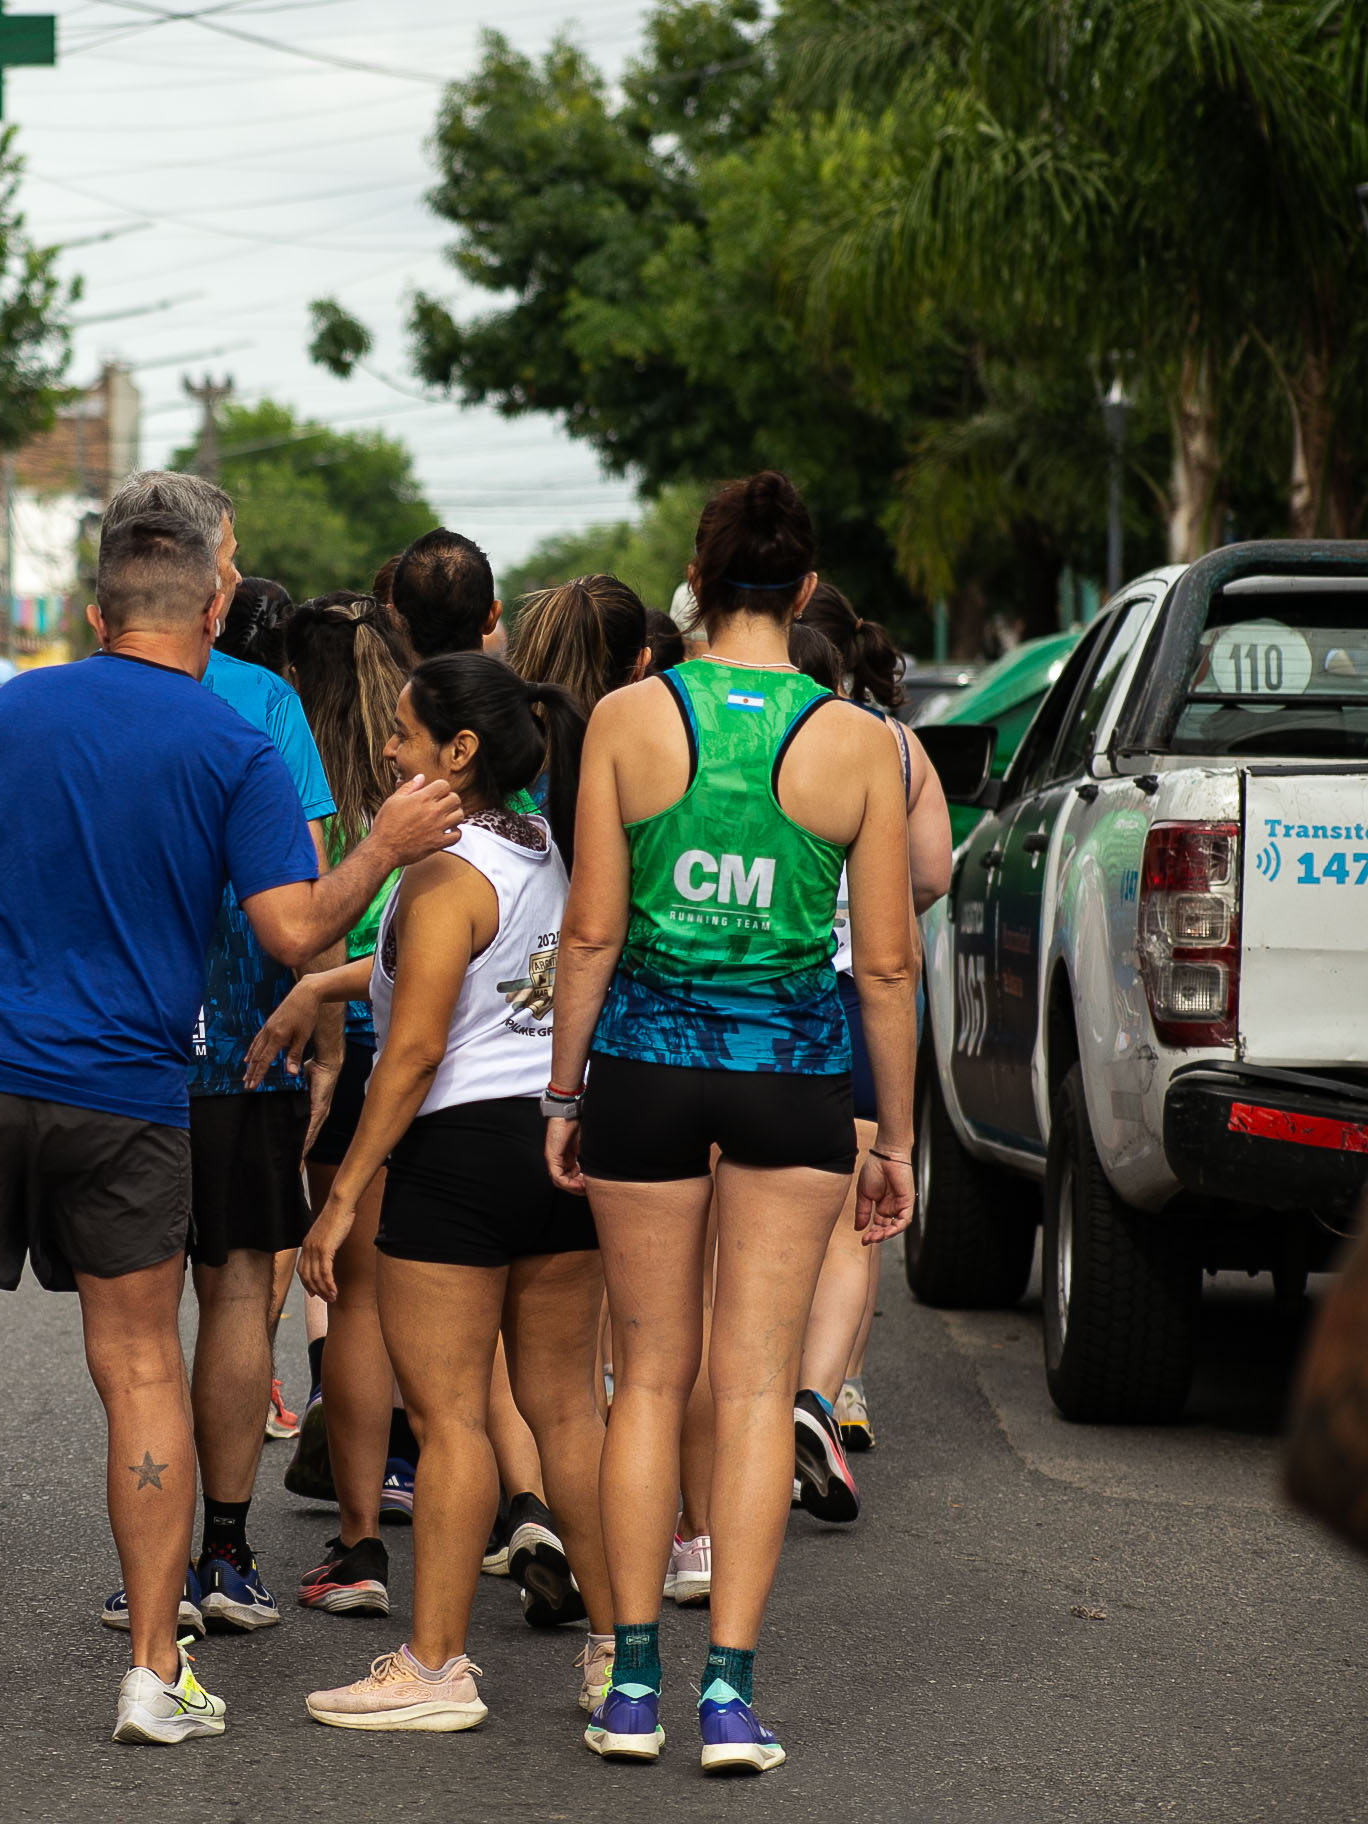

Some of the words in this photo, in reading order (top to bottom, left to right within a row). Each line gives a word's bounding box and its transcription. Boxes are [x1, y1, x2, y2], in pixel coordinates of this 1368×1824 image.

[1229, 644, 1283, 692] 110
[1264, 819, 1368, 840] Transit
[673, 849, 776, 908] CM
[1297, 852, 1368, 885] 147
[669, 911, 728, 926] RUNNING
[737, 919, 771, 931] TEAM
